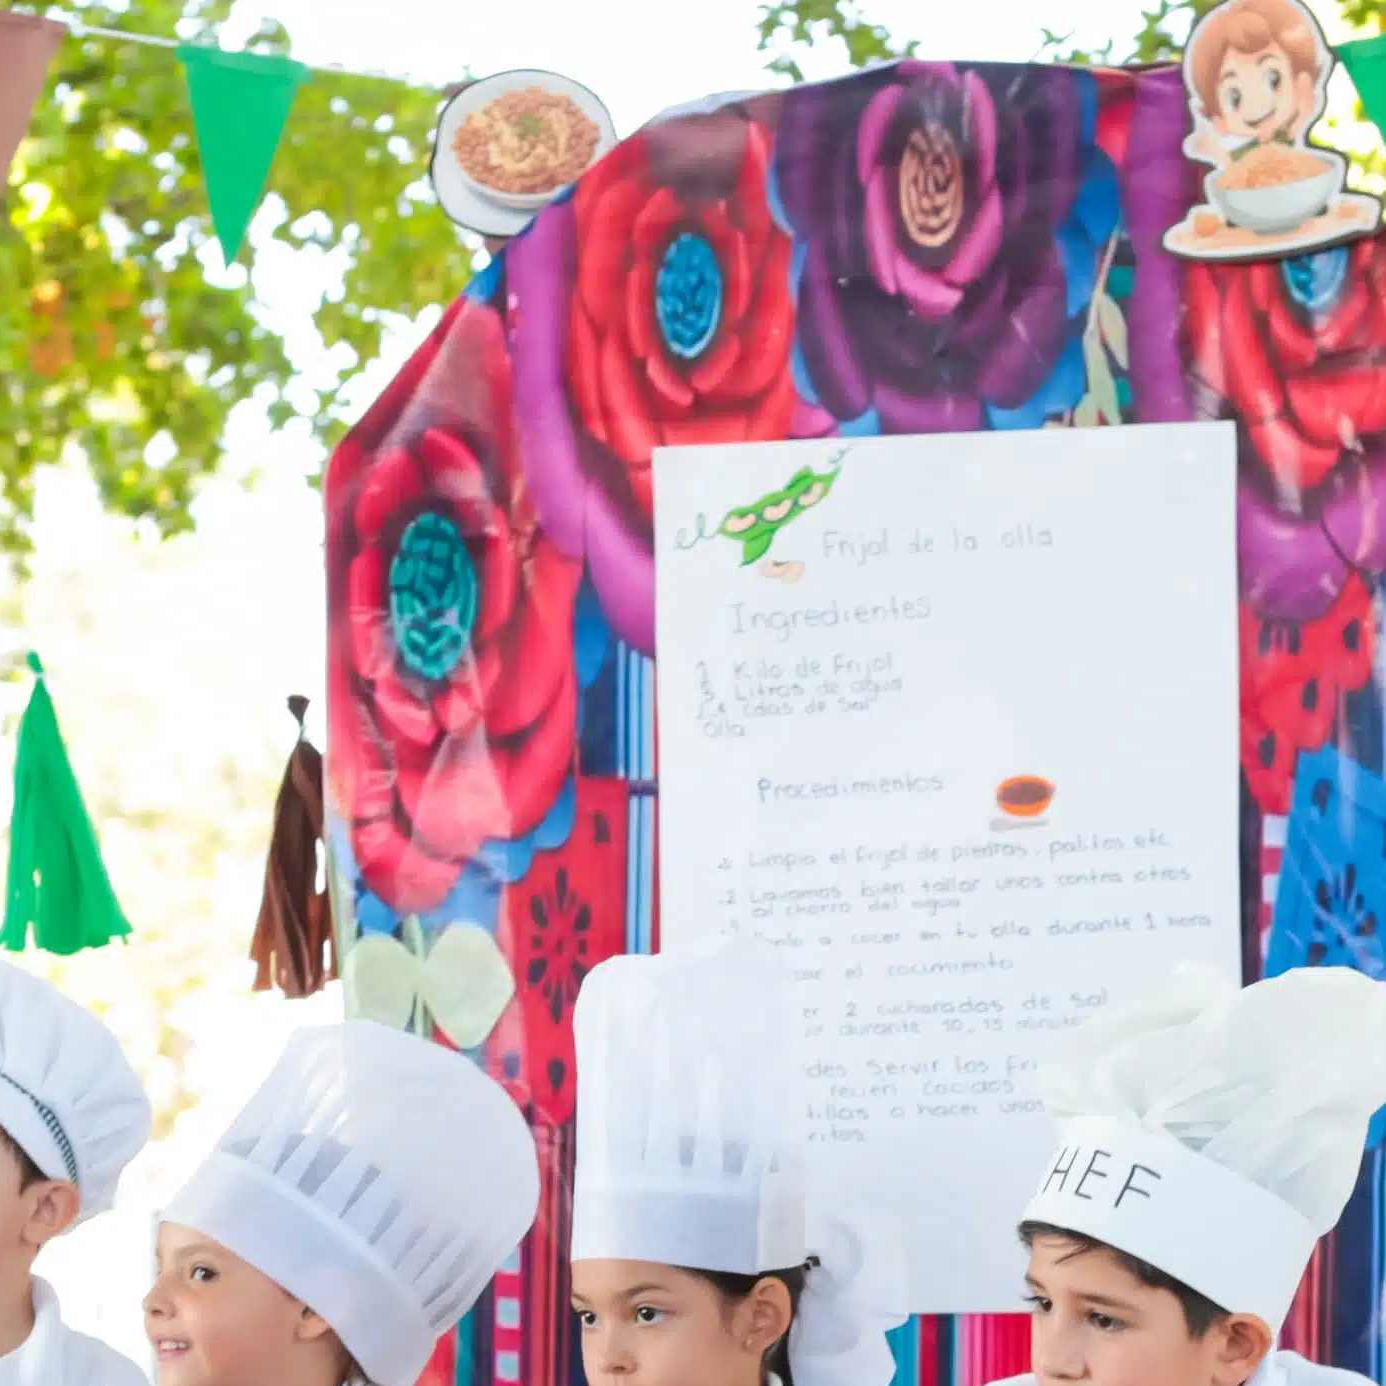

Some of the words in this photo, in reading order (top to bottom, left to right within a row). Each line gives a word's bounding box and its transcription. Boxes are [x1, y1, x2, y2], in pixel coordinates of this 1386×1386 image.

[908, 527, 935, 554] de
[952, 525, 980, 552] la
[1000, 518, 1055, 547] olla
[728, 594, 932, 644] Ingredientes
[795, 656, 822, 679] de
[828, 847, 847, 865] el
[1021, 992, 1050, 1010] de
[1042, 1146, 1162, 1208] HEF
